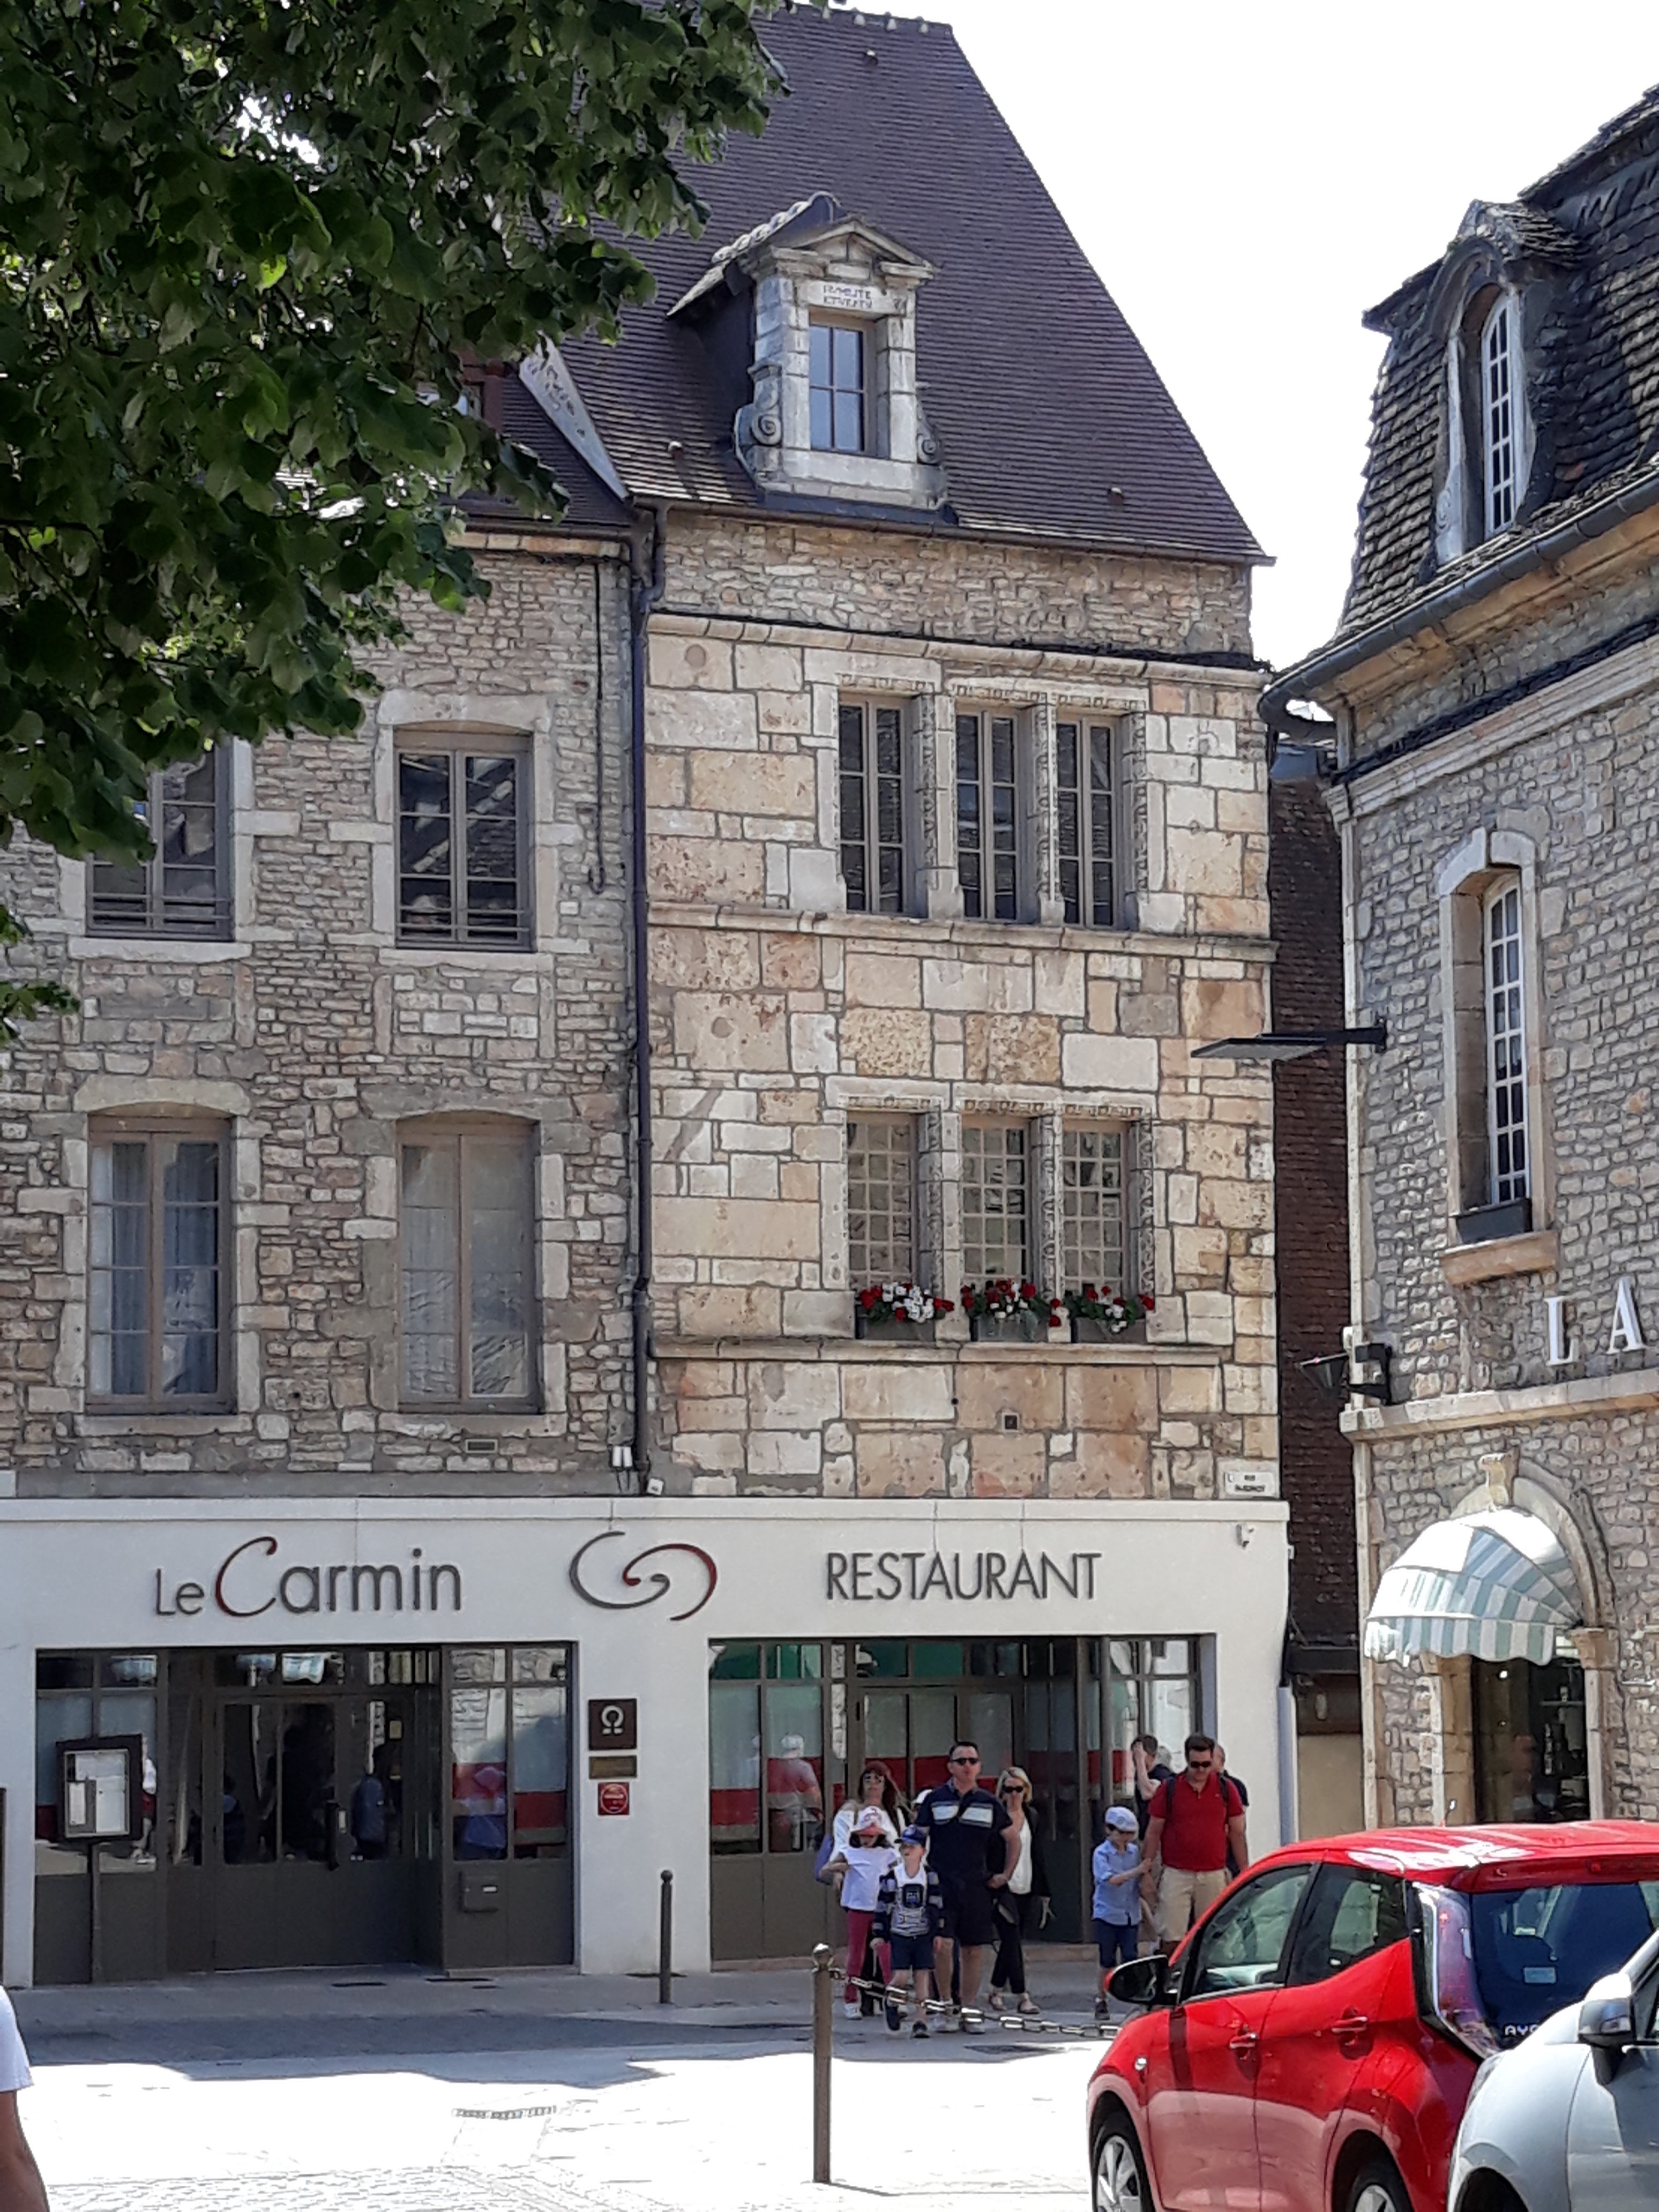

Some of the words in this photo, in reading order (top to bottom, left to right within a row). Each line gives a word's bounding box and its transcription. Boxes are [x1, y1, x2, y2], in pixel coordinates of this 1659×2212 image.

[155, 1568, 205, 1615] Le
[215, 1536, 461, 1617] Carmin
[826, 1551, 1102, 1601] RESTAURANT
